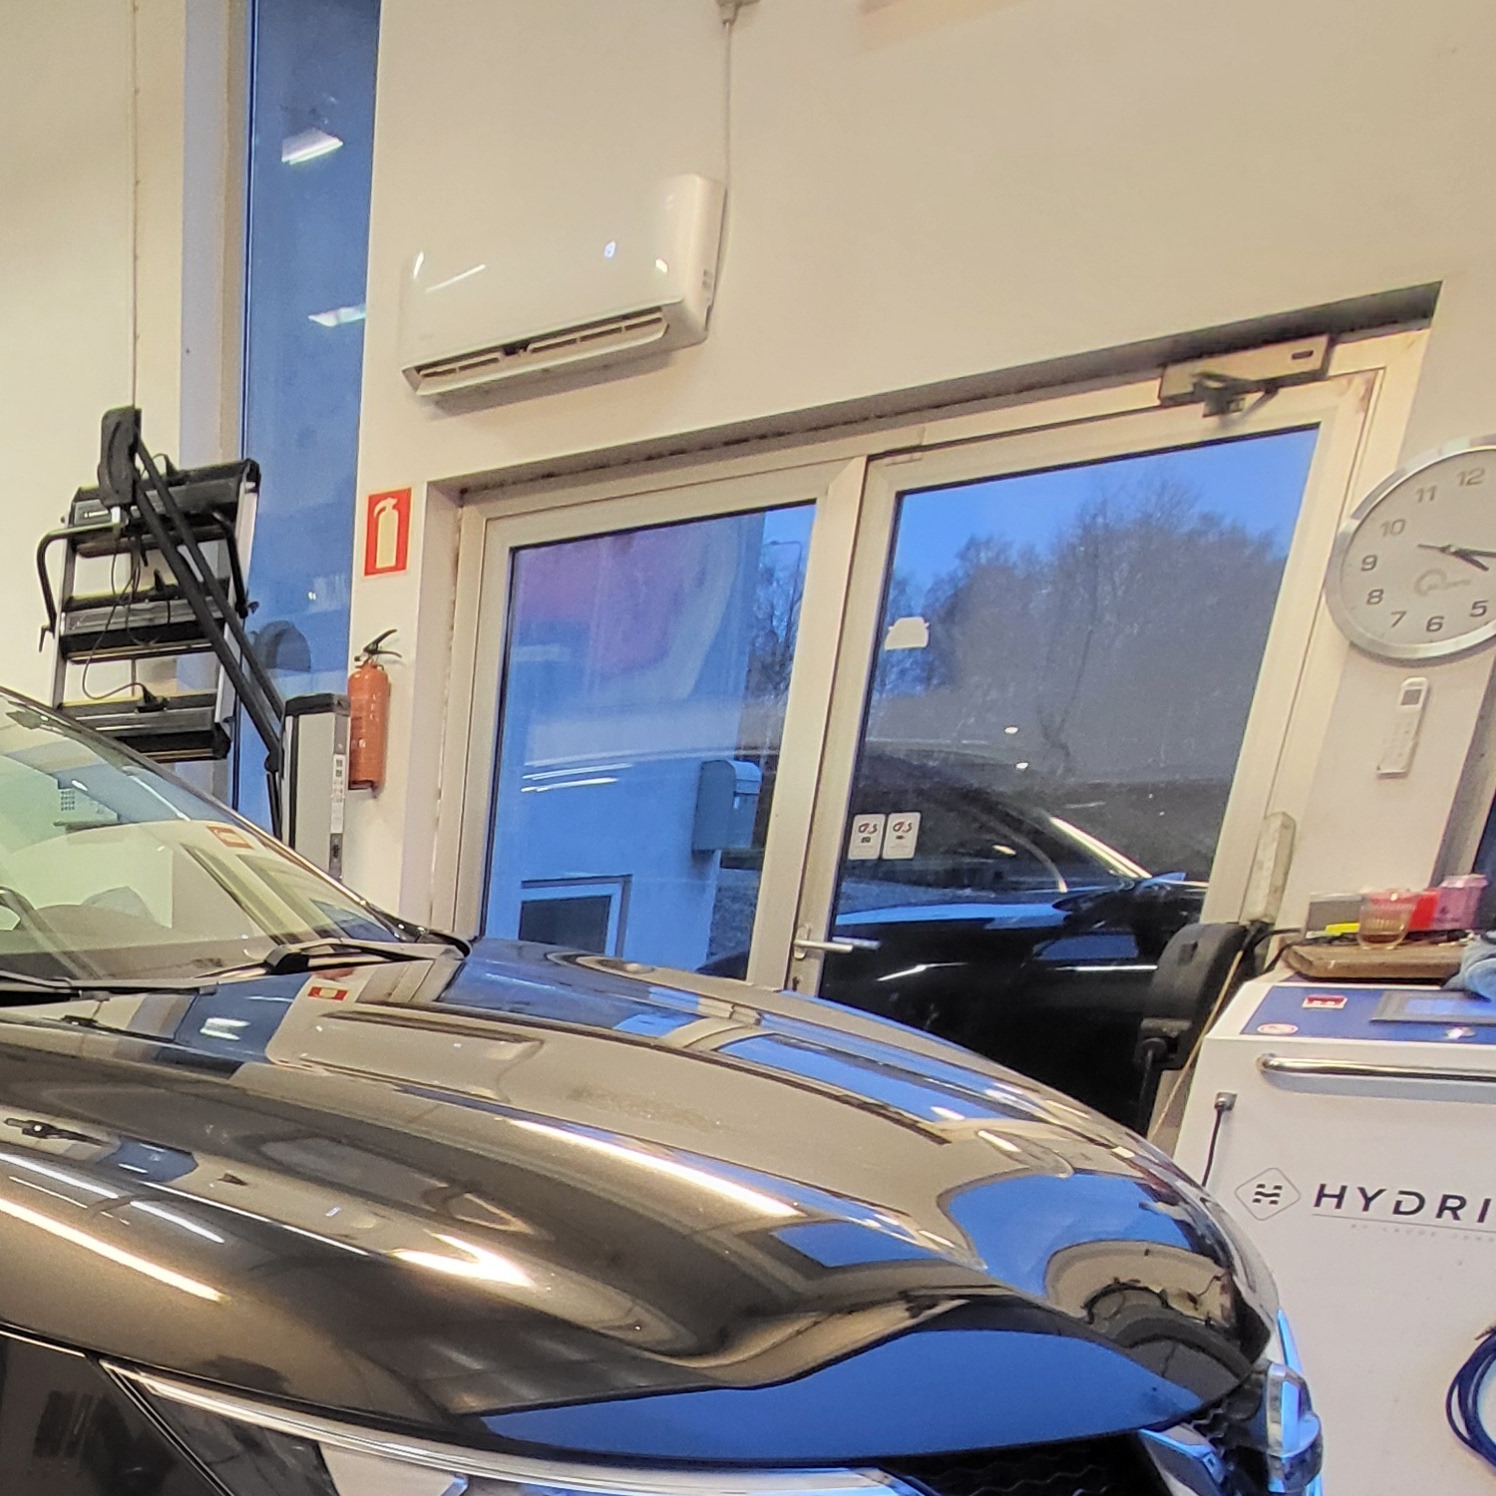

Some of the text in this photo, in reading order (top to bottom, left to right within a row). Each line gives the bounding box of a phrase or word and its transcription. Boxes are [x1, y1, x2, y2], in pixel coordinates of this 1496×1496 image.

[1457, 467, 1485, 486] 12
[1415, 485, 1437, 503] 11
[1380, 519, 1406, 537] 10
[1360, 555, 1378, 571] 9
[1366, 589, 1384, 605] 8
[1469, 600, 1489, 617] 5
[1391, 611, 1407, 628] 7
[1426, 616, 1444, 632] 6
